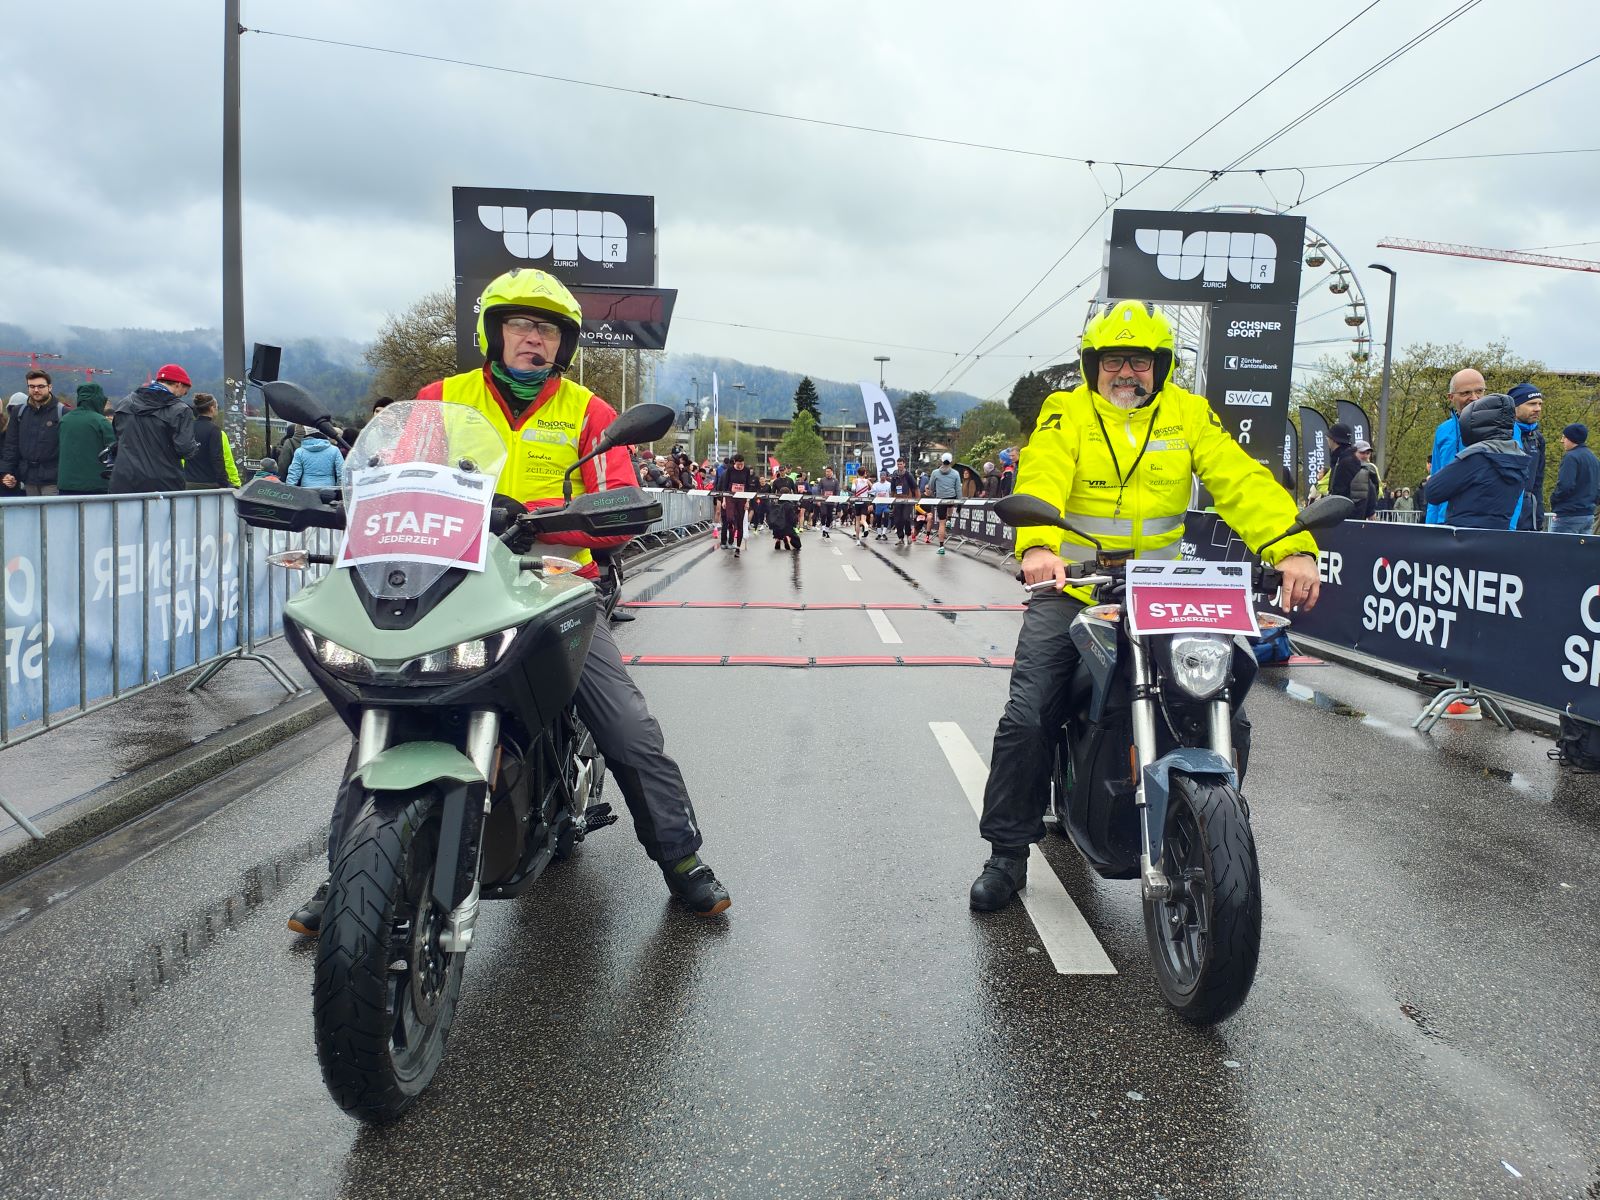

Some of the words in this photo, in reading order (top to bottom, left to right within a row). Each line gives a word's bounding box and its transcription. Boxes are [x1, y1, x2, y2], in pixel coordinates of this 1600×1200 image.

[1230, 320, 1282, 331] OCHSNER
[579, 331, 634, 341] NORQAIN
[1226, 328, 1262, 338] SPORT
[1228, 390, 1270, 405] SWICA
[873, 401, 890, 425] A
[528, 451, 552, 460] Sandro
[877, 433, 896, 470] OCK
[257, 487, 295, 501] elfar.ch
[593, 495, 630, 507] elfar.ch
[364, 511, 465, 538] STAFF
[378, 534, 440, 546] JEDERZEIT
[1372, 556, 1524, 618] OCHSNER
[1149, 602, 1233, 618] STAFF
[559, 619, 575, 633] ZERO
[1362, 594, 1457, 649] SPORT
